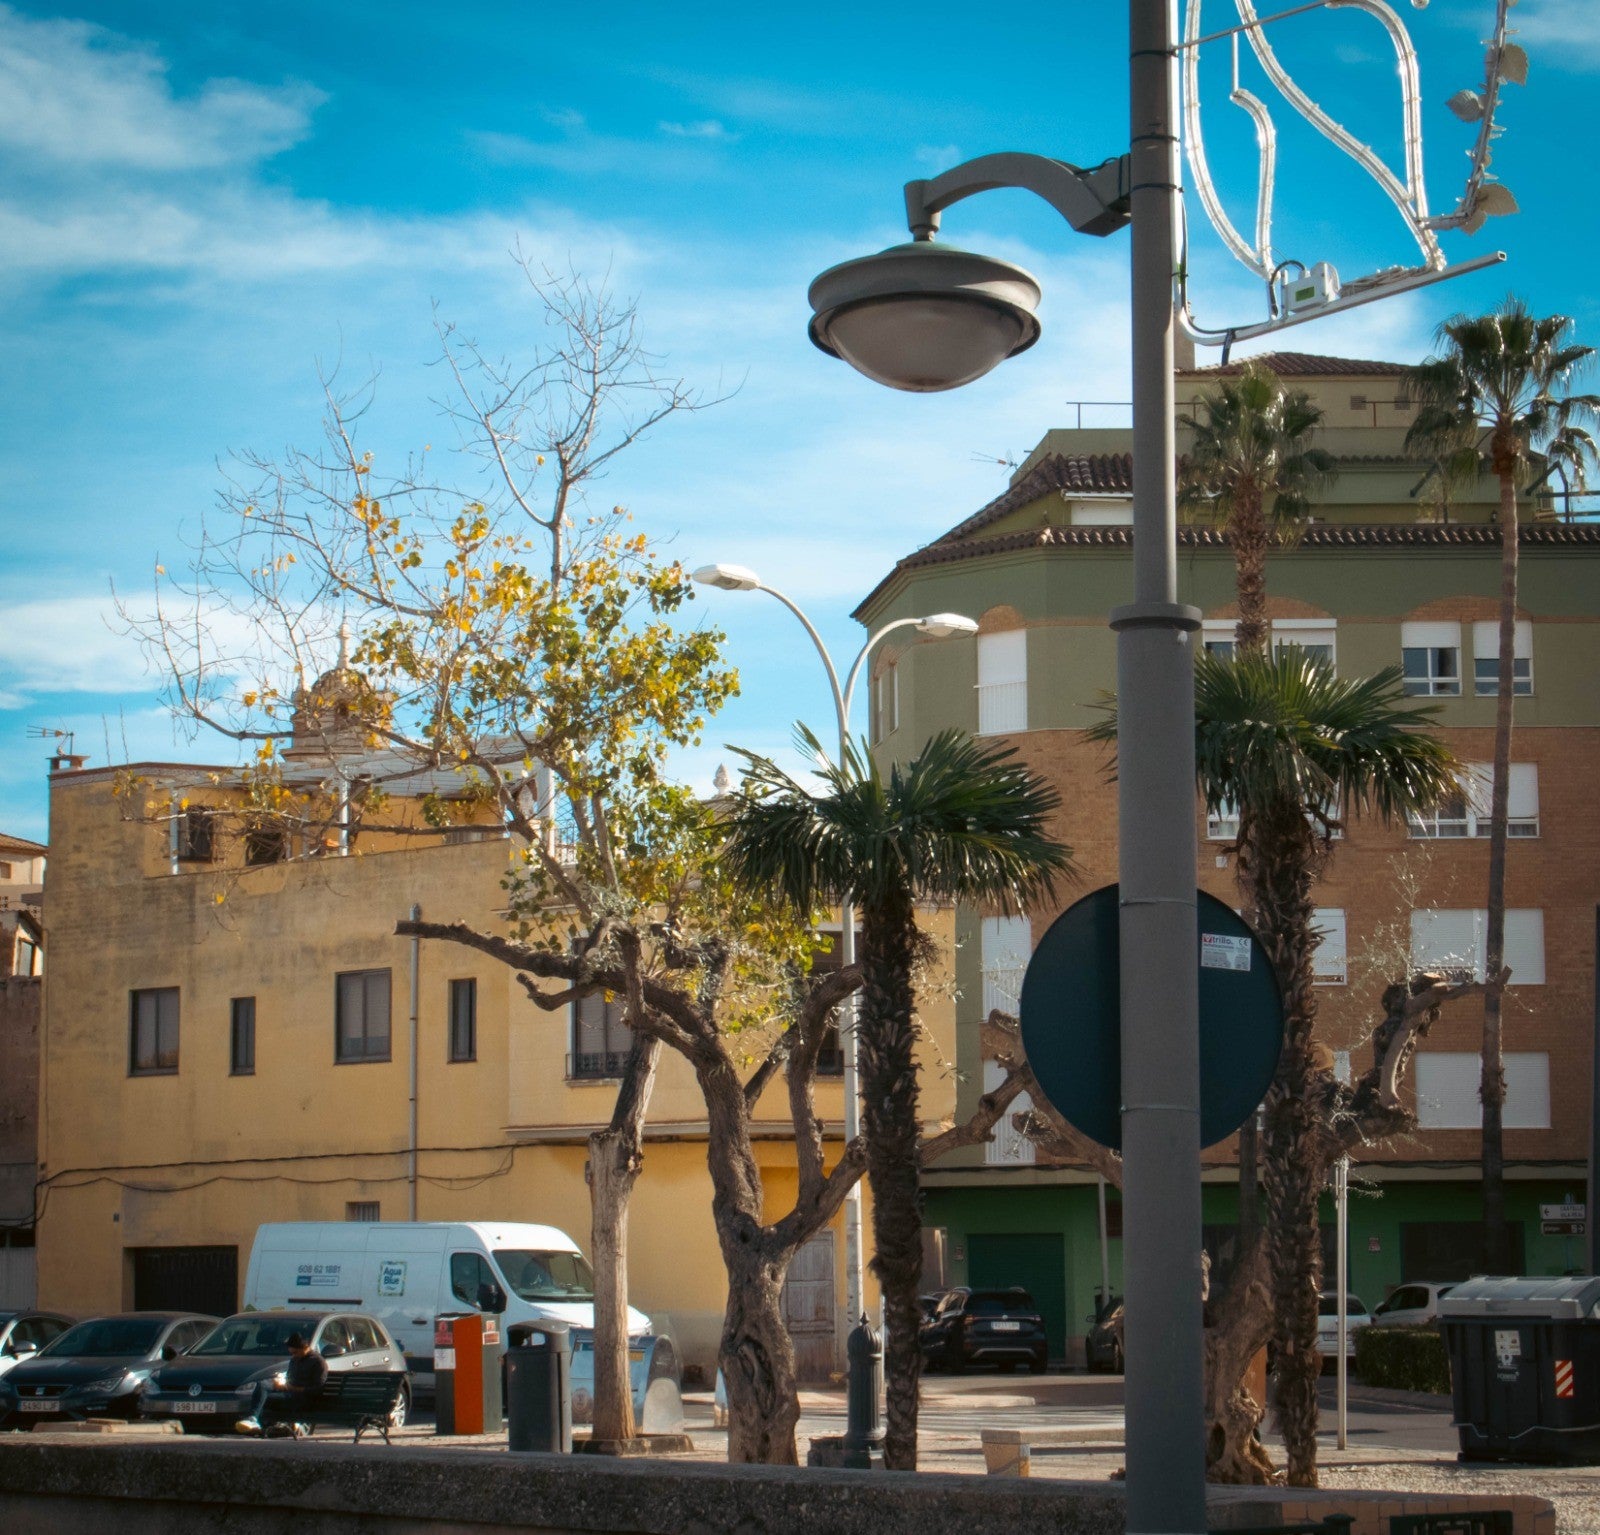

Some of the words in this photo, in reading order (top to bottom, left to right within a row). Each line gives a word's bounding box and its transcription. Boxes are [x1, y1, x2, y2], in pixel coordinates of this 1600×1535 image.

[298, 1264, 313, 1273] 608
[313, 1264, 323, 1273] 62
[384, 1276, 400, 1285] Blue
[176, 1402, 196, 1412] 5961
